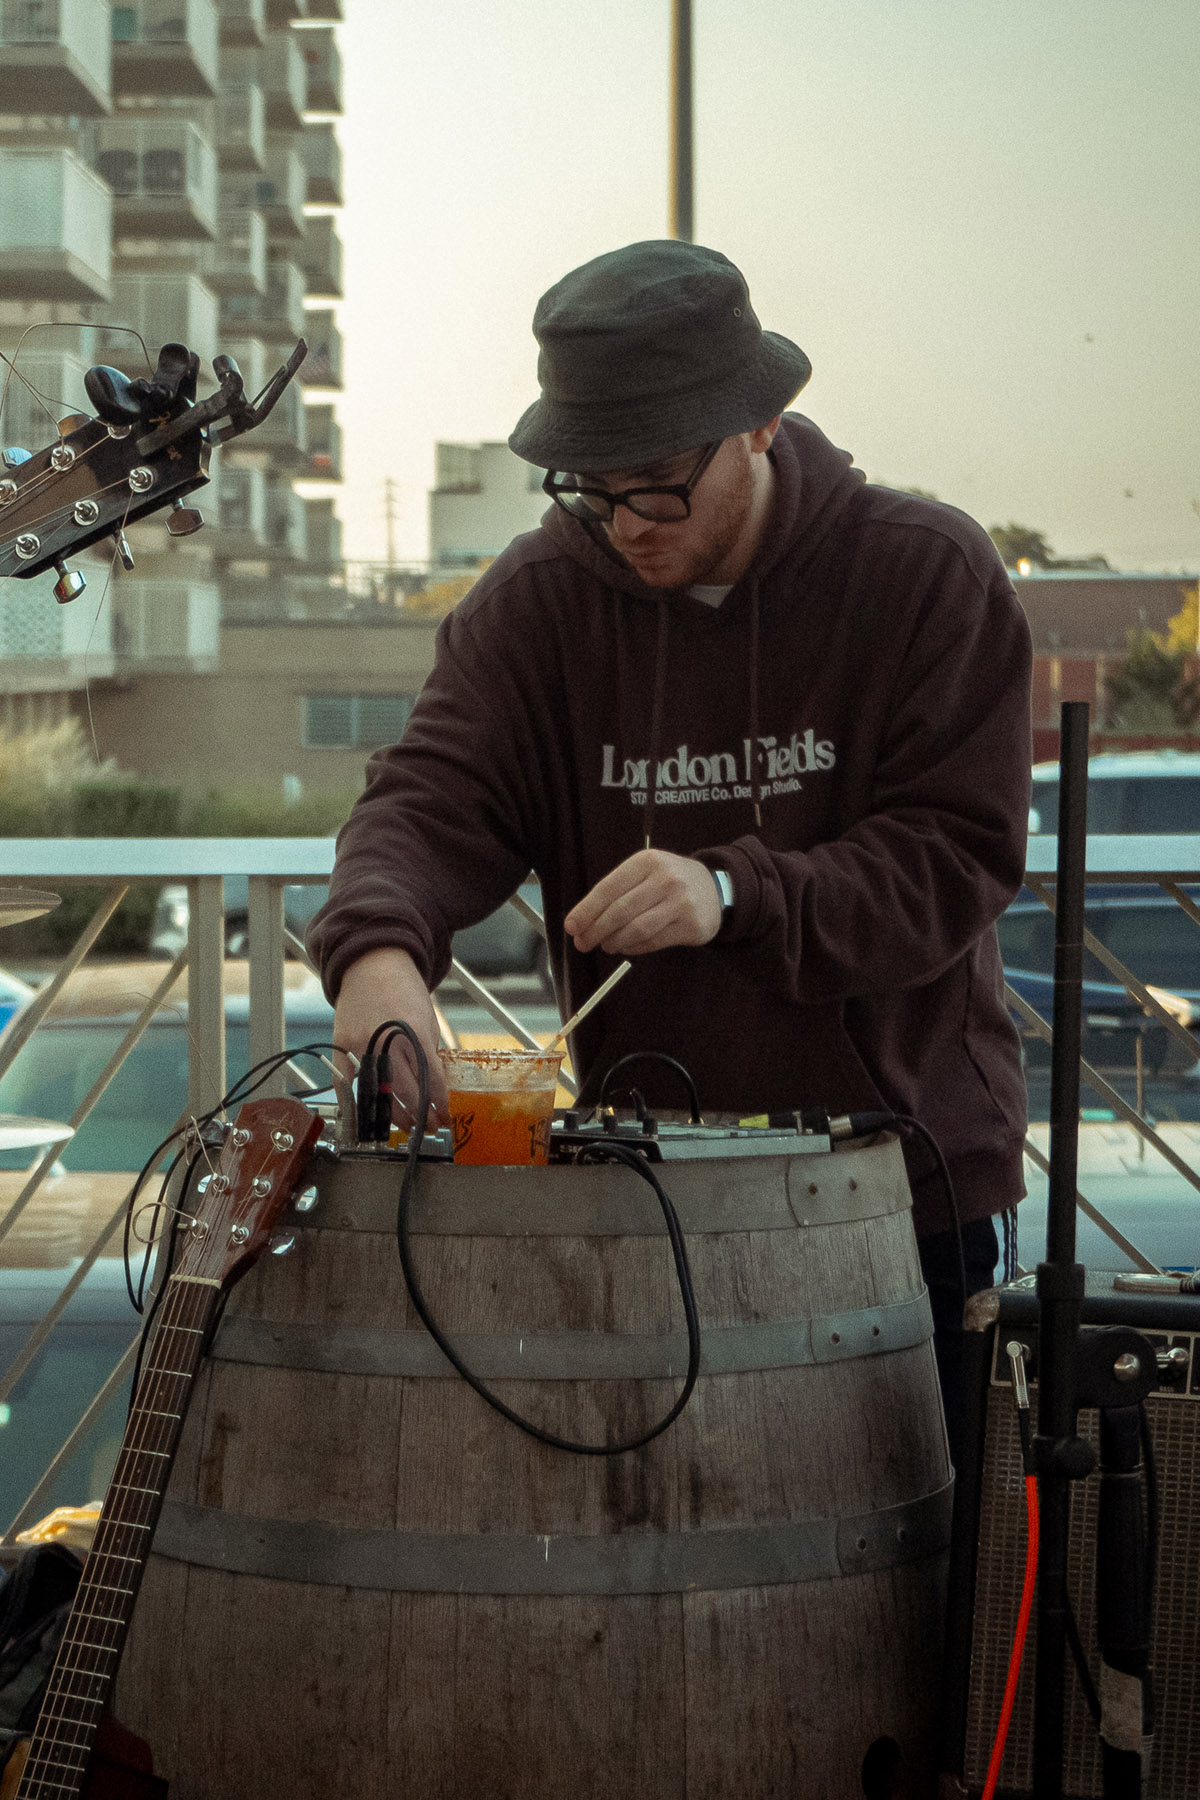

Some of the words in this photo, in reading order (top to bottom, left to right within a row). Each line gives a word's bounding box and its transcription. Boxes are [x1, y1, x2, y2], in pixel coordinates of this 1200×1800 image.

[600, 744, 738, 788] London
[654, 788, 710, 805] CREATIVE
[711, 787, 732, 801] Co.
